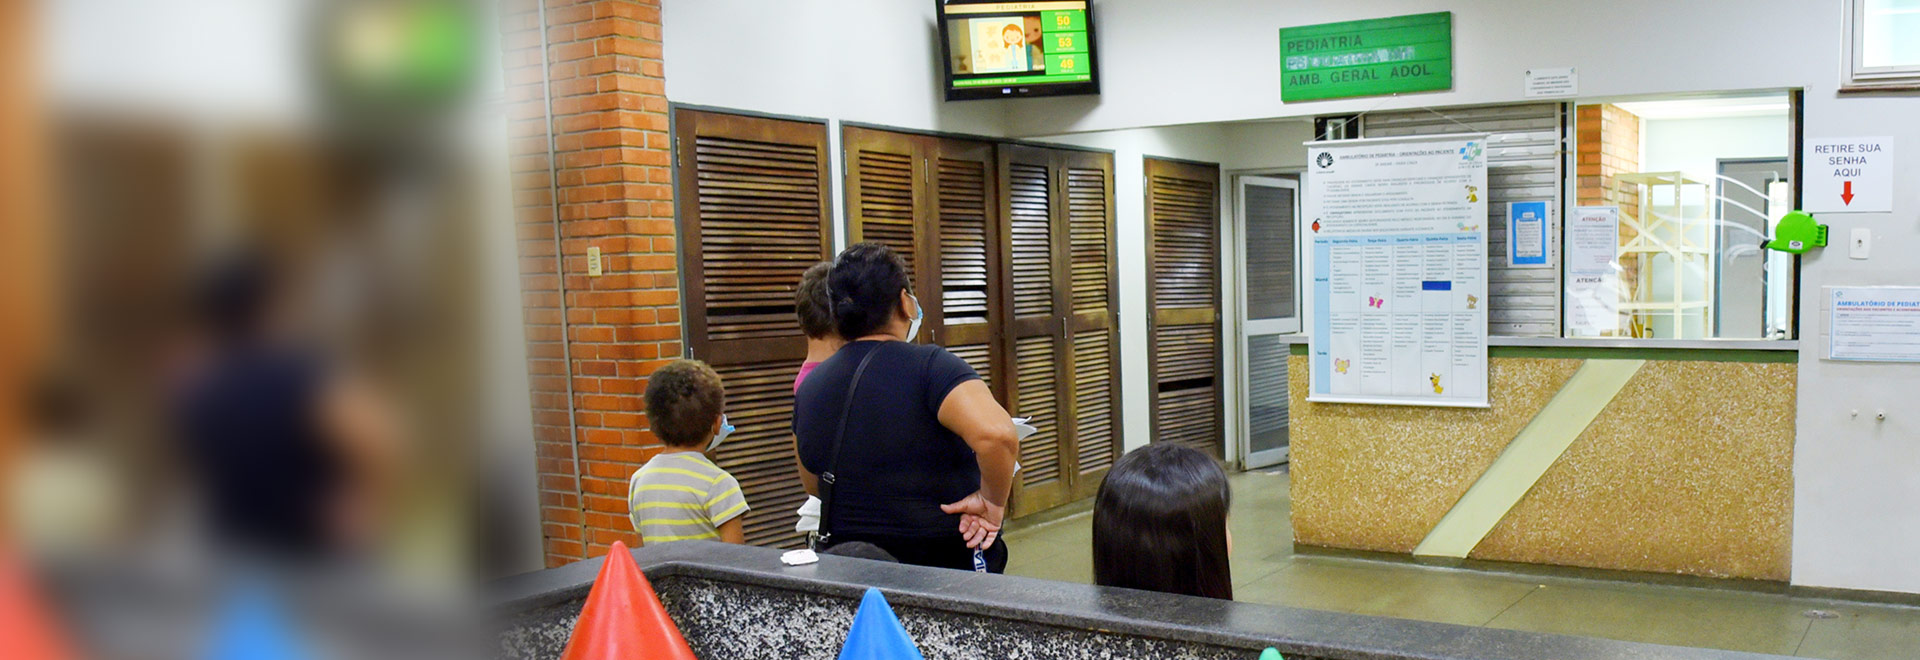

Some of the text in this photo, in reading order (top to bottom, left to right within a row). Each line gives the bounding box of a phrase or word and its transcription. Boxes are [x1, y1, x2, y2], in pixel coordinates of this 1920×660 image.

[1056, 15, 1070, 26] 50
[1058, 37, 1072, 48] 53
[1287, 35, 1363, 53] PEDIATRIA
[1060, 59, 1074, 69] 49
[1289, 72, 1323, 86] AMB.
[1330, 68, 1380, 83] GERAL
[1814, 143, 1882, 154] RETIRE SUA
[1828, 156, 1868, 165] SENHA
[1833, 168, 1861, 177] AQUI
[974, 551, 986, 573] ILA
